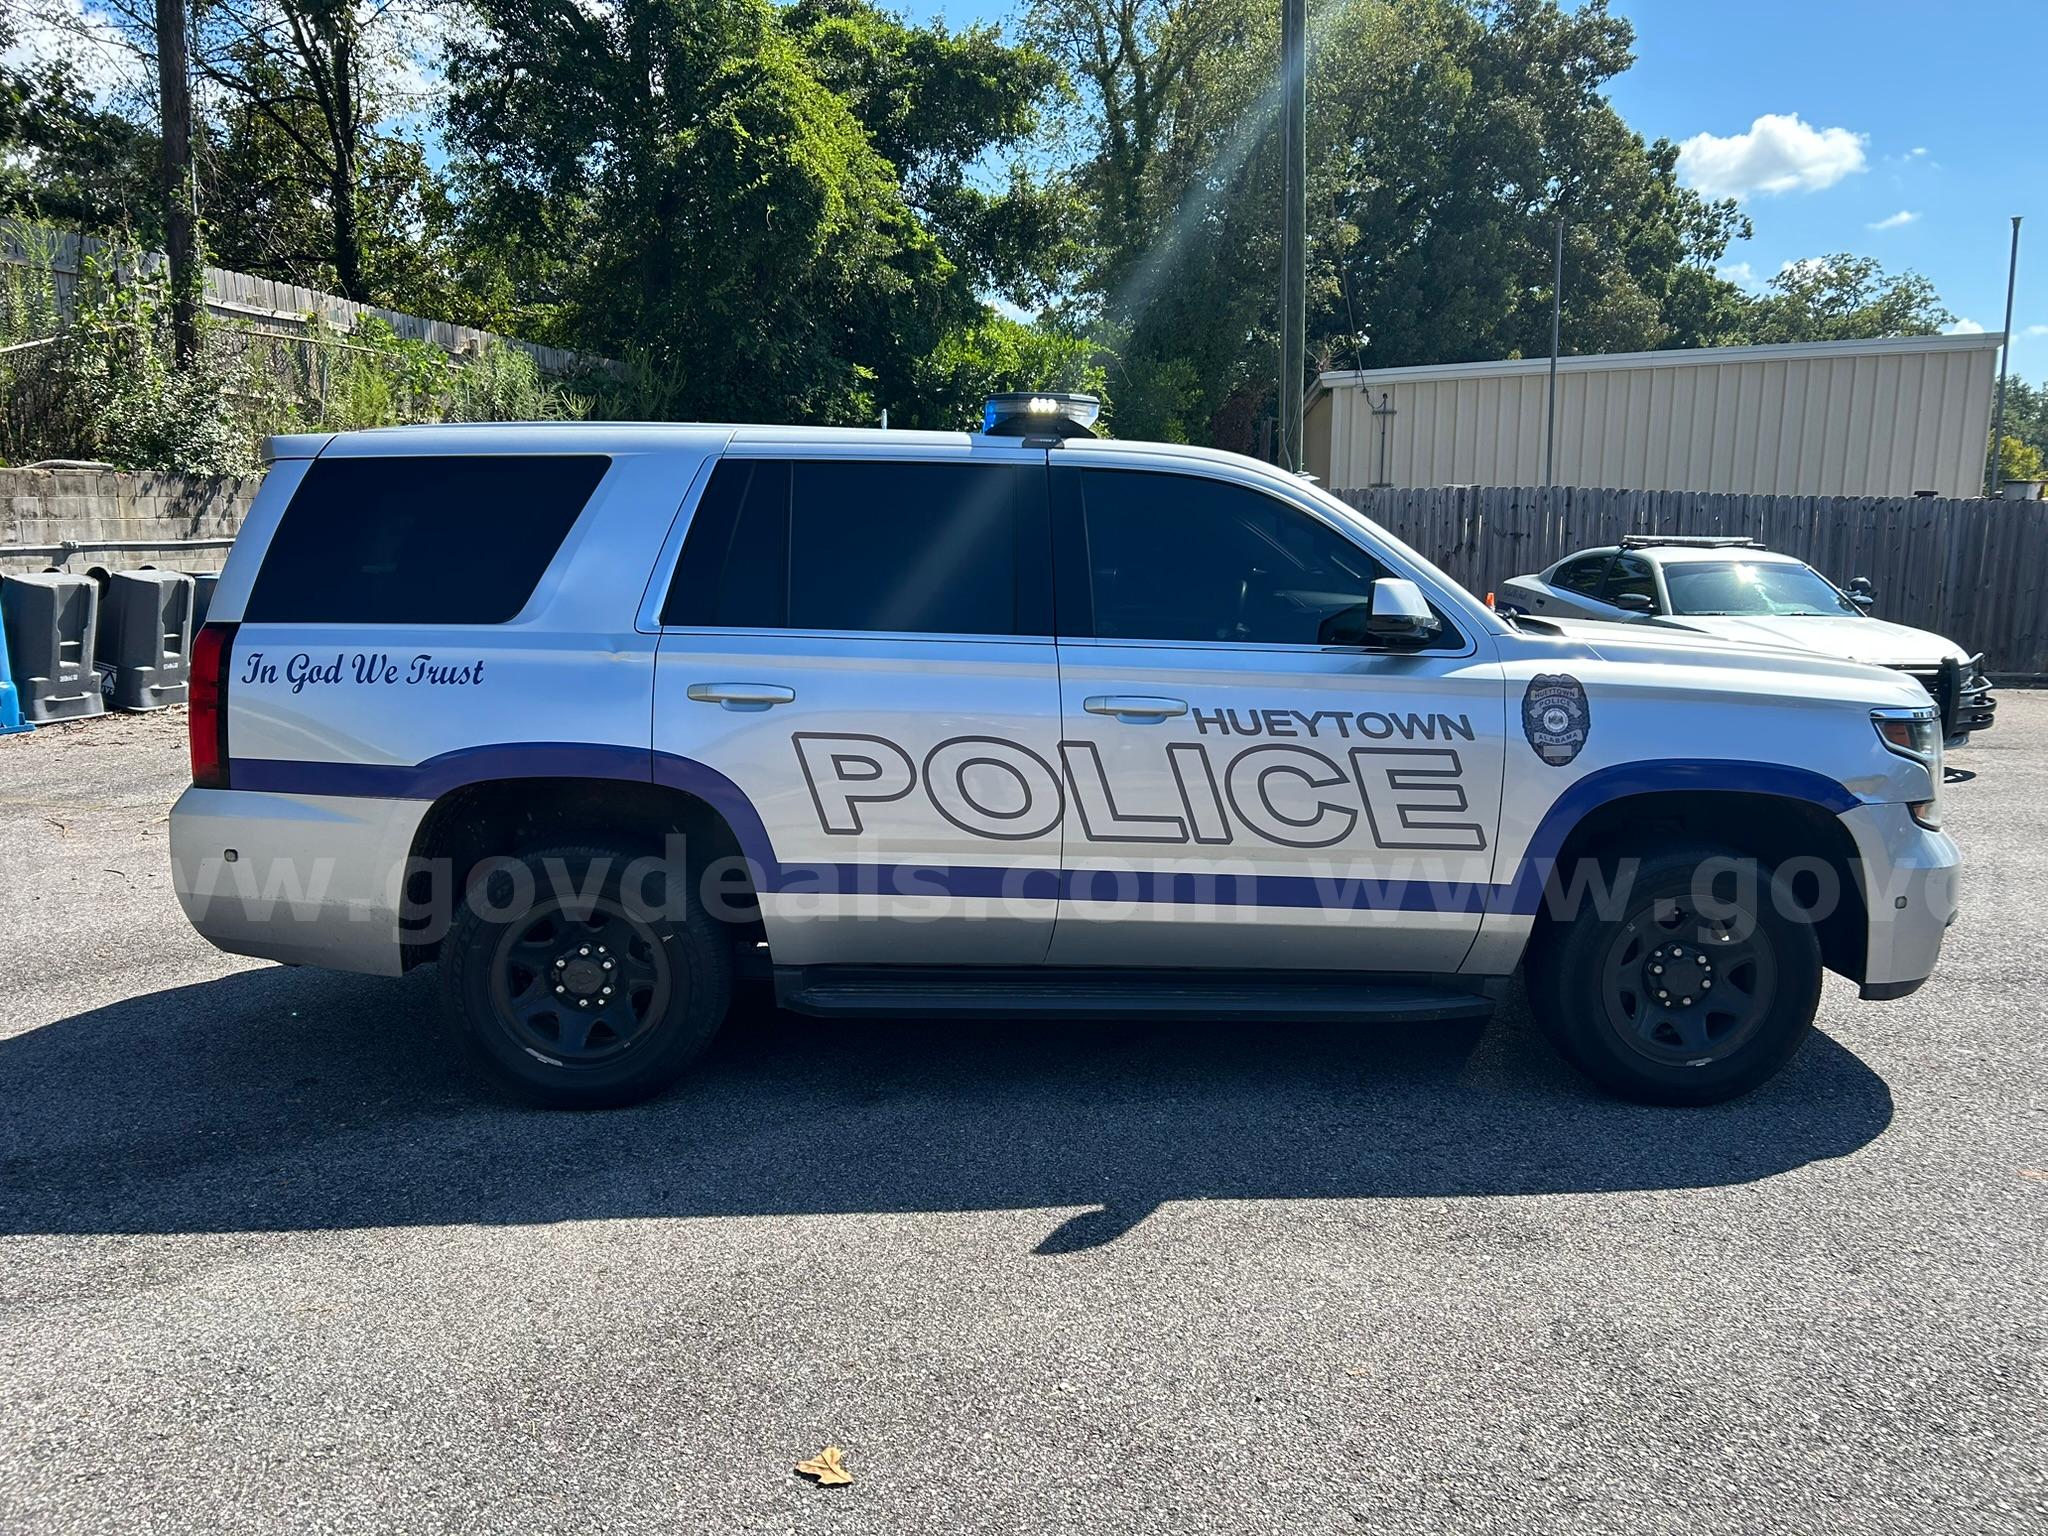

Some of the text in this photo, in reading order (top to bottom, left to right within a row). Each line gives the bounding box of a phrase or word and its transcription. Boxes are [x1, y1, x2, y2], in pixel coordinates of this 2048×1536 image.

[241, 652, 485, 694] In God We Trust
[1539, 698, 1572, 707] POLICE
[1191, 706, 1476, 742] HUEYTOWN
[1538, 731, 1578, 744] ALABAMA
[791, 731, 1487, 850] POLICE
